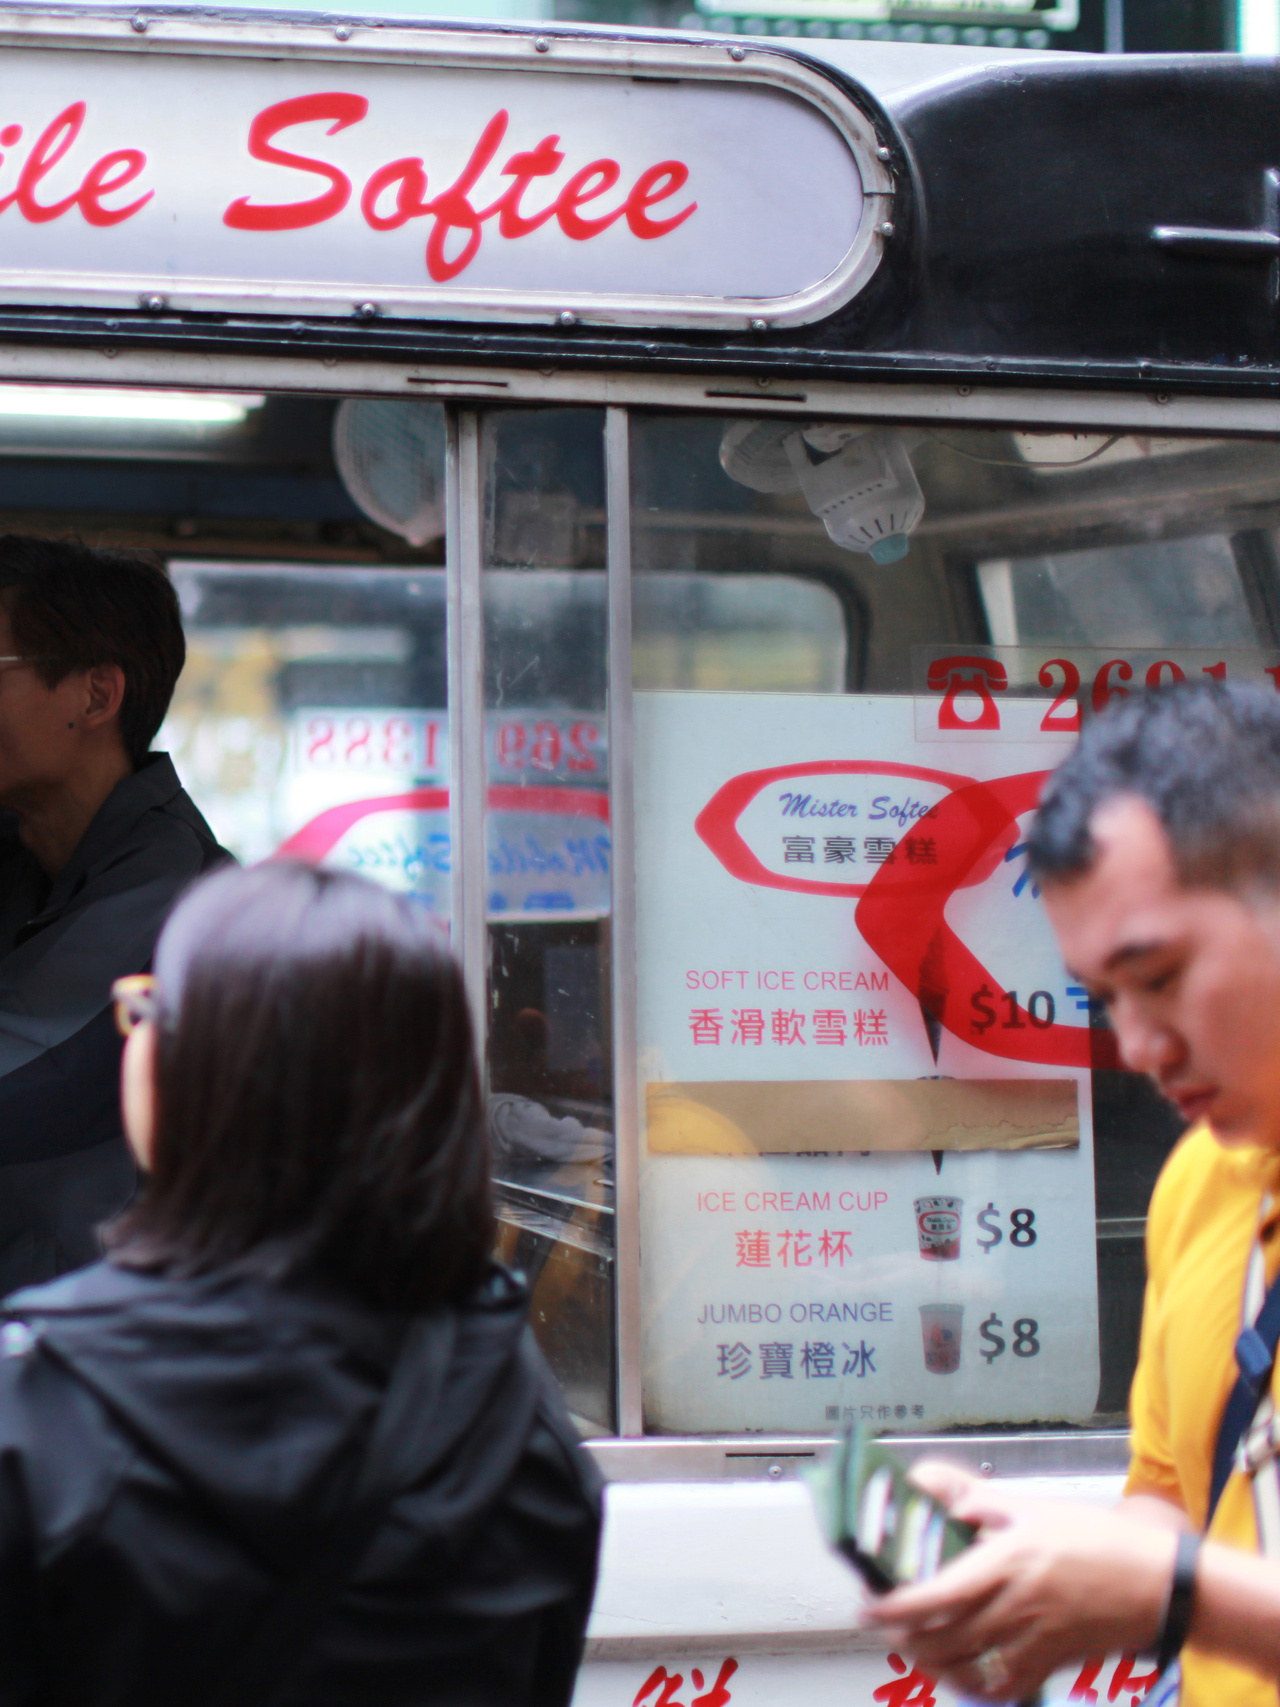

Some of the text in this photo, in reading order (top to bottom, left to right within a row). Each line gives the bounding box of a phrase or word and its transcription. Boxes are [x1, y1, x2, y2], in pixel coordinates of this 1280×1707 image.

[224, 92, 698, 284] Softee
[779, 793, 938, 827] Mister Softee
[783, 836, 938, 865] 富豪雪糕
[686, 970, 889, 991] SOFT ICE CREAM
[688, 1009, 889, 1046] 香滑軟雪糕
[970, 986, 1055, 1034] $10
[698, 1192, 888, 1212] ICE CREAM CUP
[977, 1202, 1037, 1254] $8
[735, 1229, 853, 1267] 蓮花杯
[697, 1302, 893, 1324] JUMBO ORANGE
[980, 1313, 1040, 1364] $8
[717, 1340, 876, 1379] 珍寶橙冰
